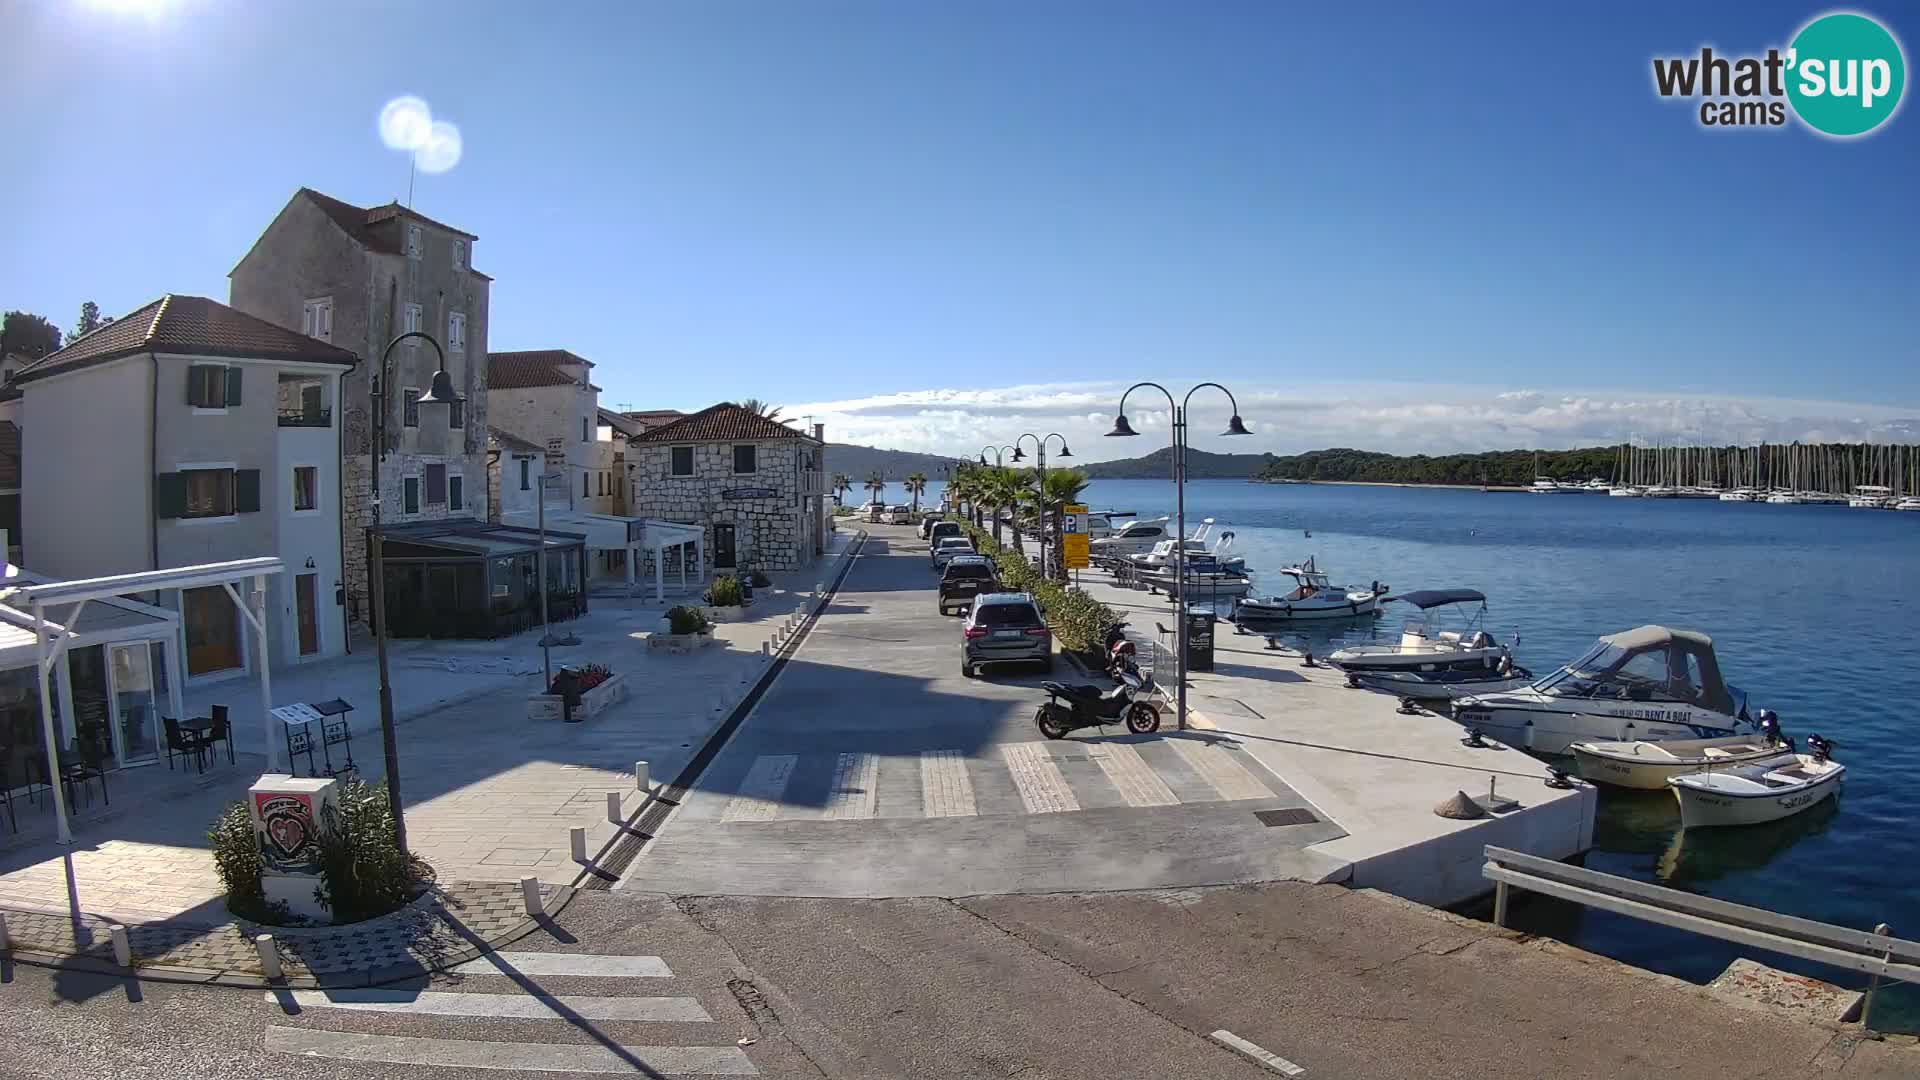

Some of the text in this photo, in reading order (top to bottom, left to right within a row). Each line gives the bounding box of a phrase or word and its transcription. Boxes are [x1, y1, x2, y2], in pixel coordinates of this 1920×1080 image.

[1065, 516, 1076, 531] P
[1645, 710, 1665, 721] RENT
[1672, 711, 1692, 724] BOAT
